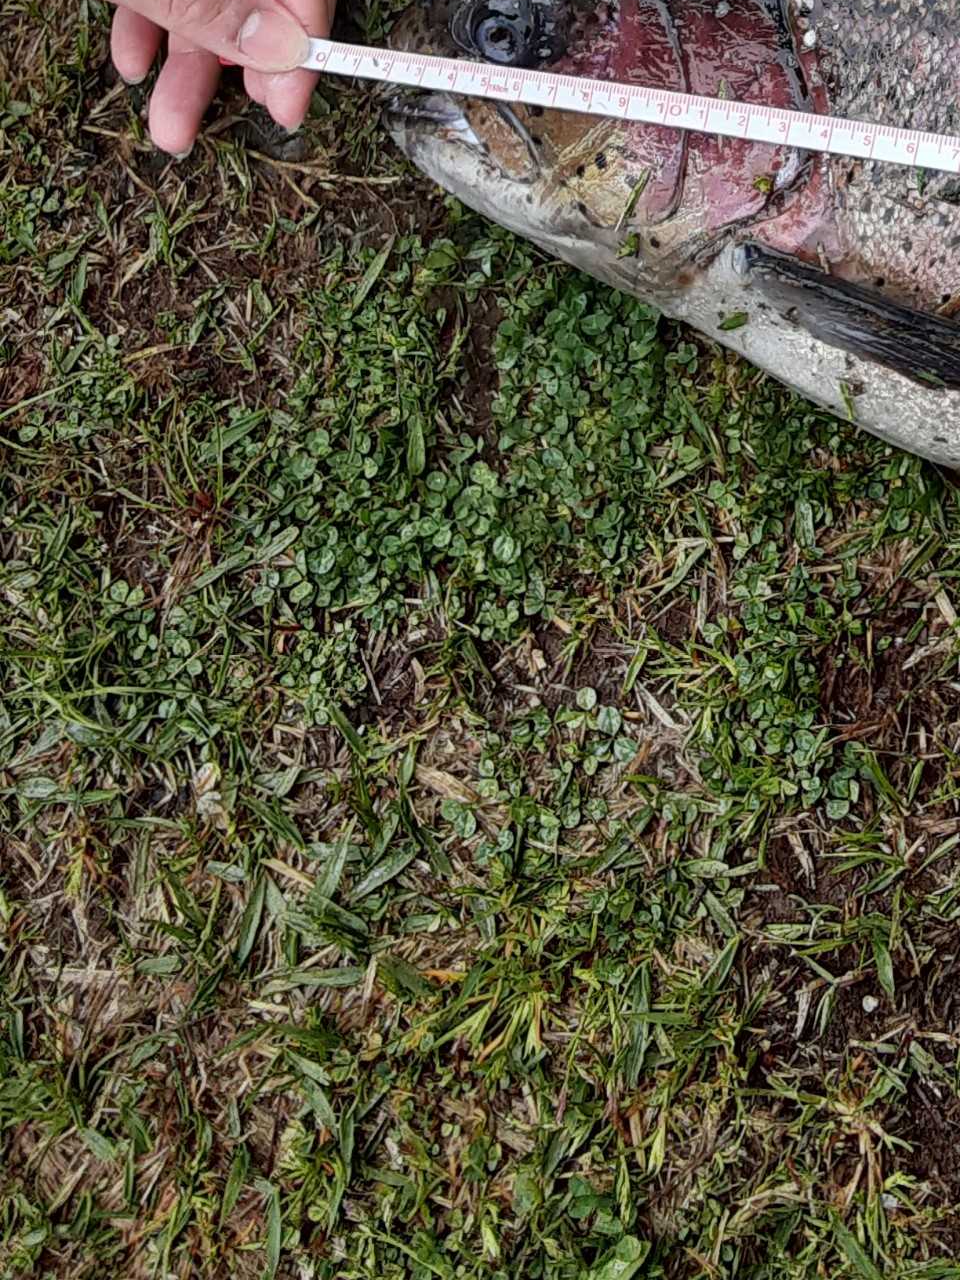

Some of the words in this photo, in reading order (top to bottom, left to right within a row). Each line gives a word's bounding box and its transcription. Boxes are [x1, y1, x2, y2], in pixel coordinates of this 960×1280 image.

[382, 62, 390, 72] 2
[513, 81, 520, 91] 6
[548, 86, 555, 96] 7
[618, 97, 626, 107] 9
[657, 103, 681, 117] 10
[738, 116, 745, 126] 2
[778, 122, 786, 132] 3
[820, 129, 828, 139] 4
[863, 136, 871, 146] 5
[906, 143, 914, 153] 6
[952, 150, 960, 160] 7
